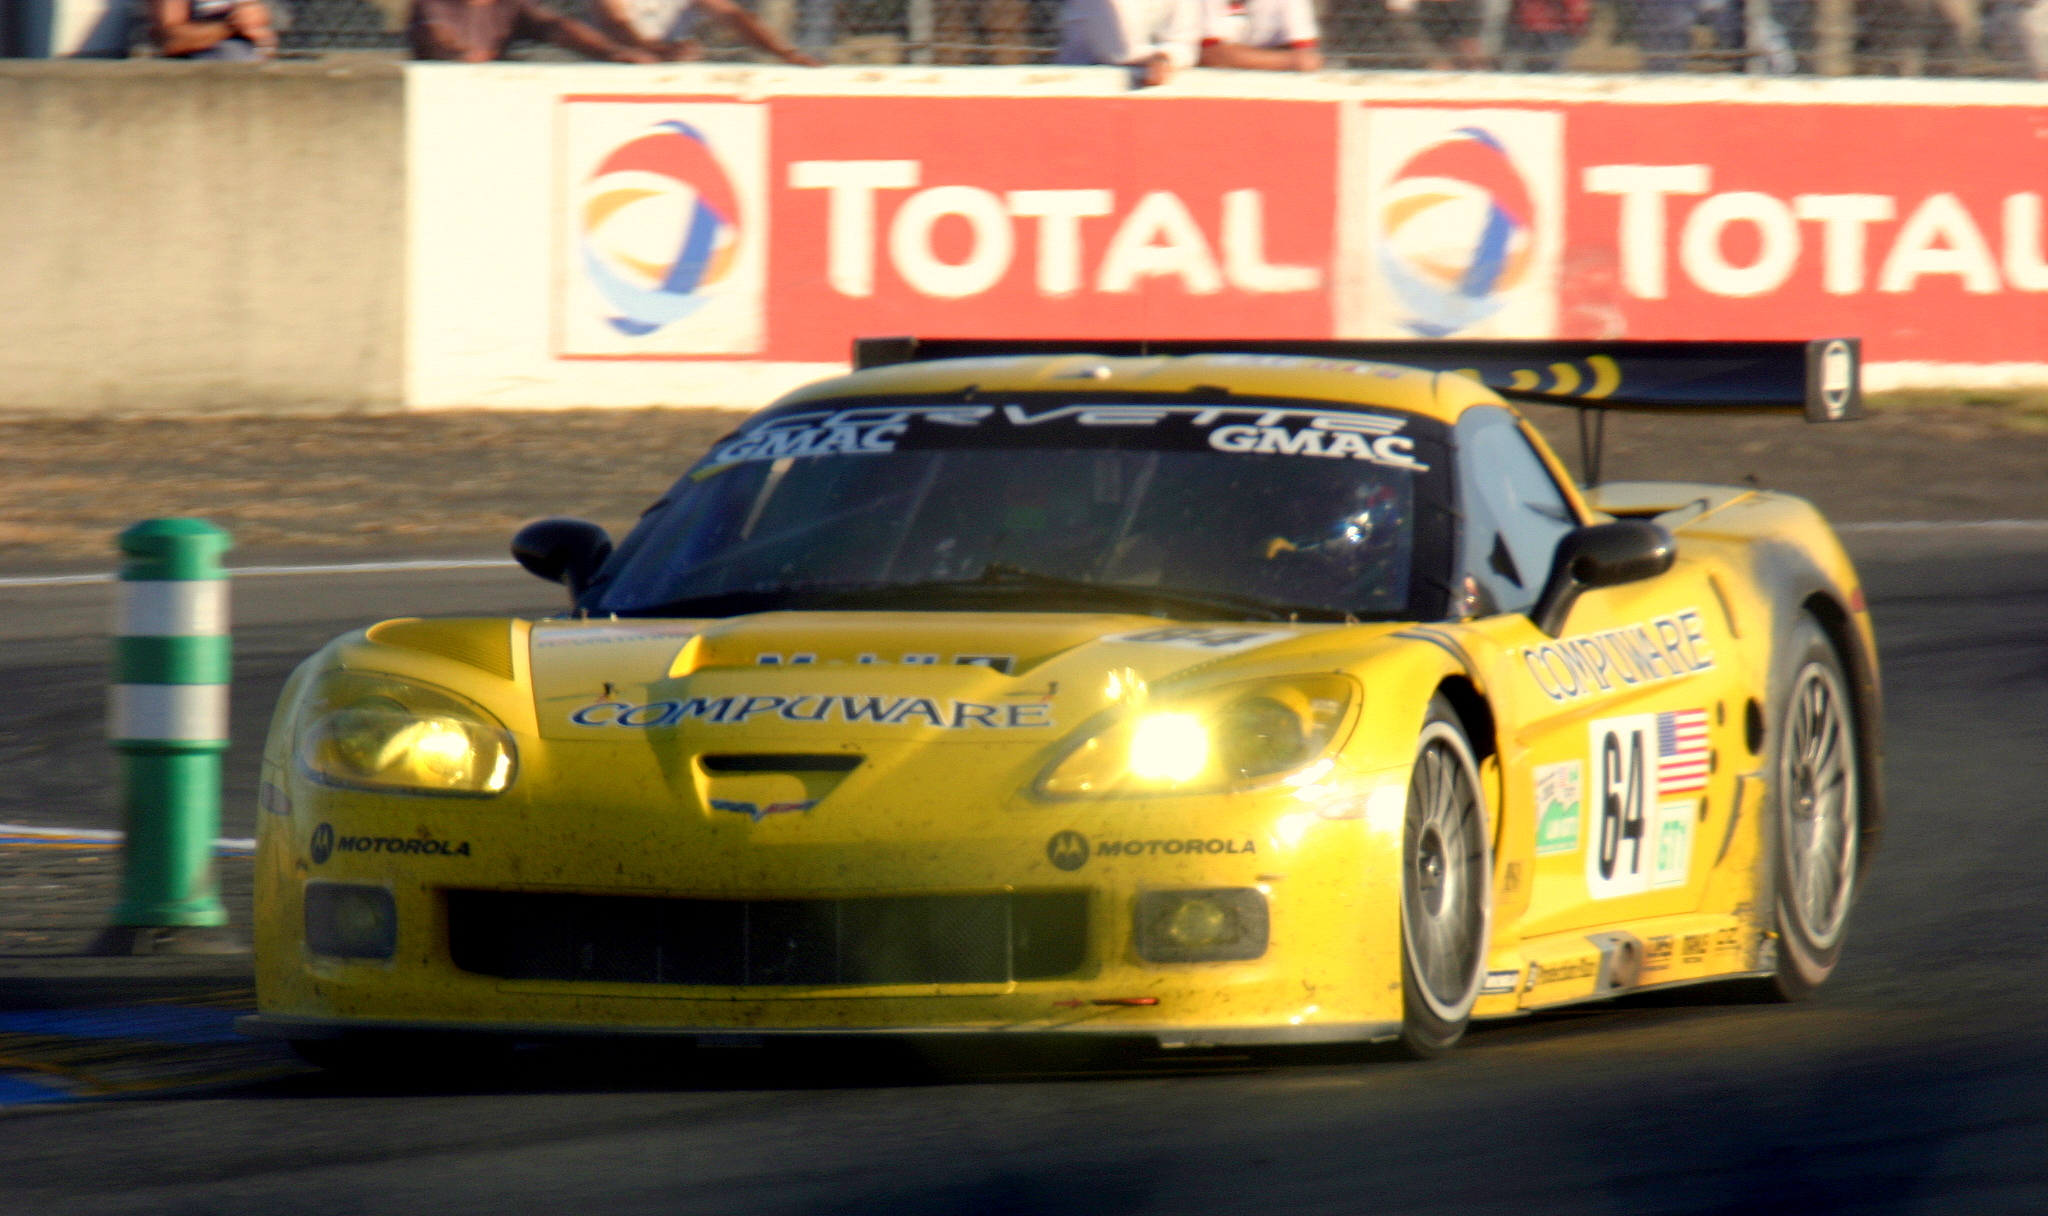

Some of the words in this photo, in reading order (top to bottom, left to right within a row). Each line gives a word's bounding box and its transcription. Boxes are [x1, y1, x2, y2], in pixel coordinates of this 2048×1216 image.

[788, 159, 1324, 299] TOTAL
[740, 403, 1409, 437] CORVETTE
[714, 422, 908, 464] GMAC
[1207, 423, 1418, 466] GMAC
[1521, 606, 1716, 702] COMPUWARE
[569, 694, 1055, 729] COMPUWARE
[1599, 729, 1645, 882] 64
[337, 835, 472, 858] MOTOROLA
[1096, 838, 1258, 857] MOTOROLA
